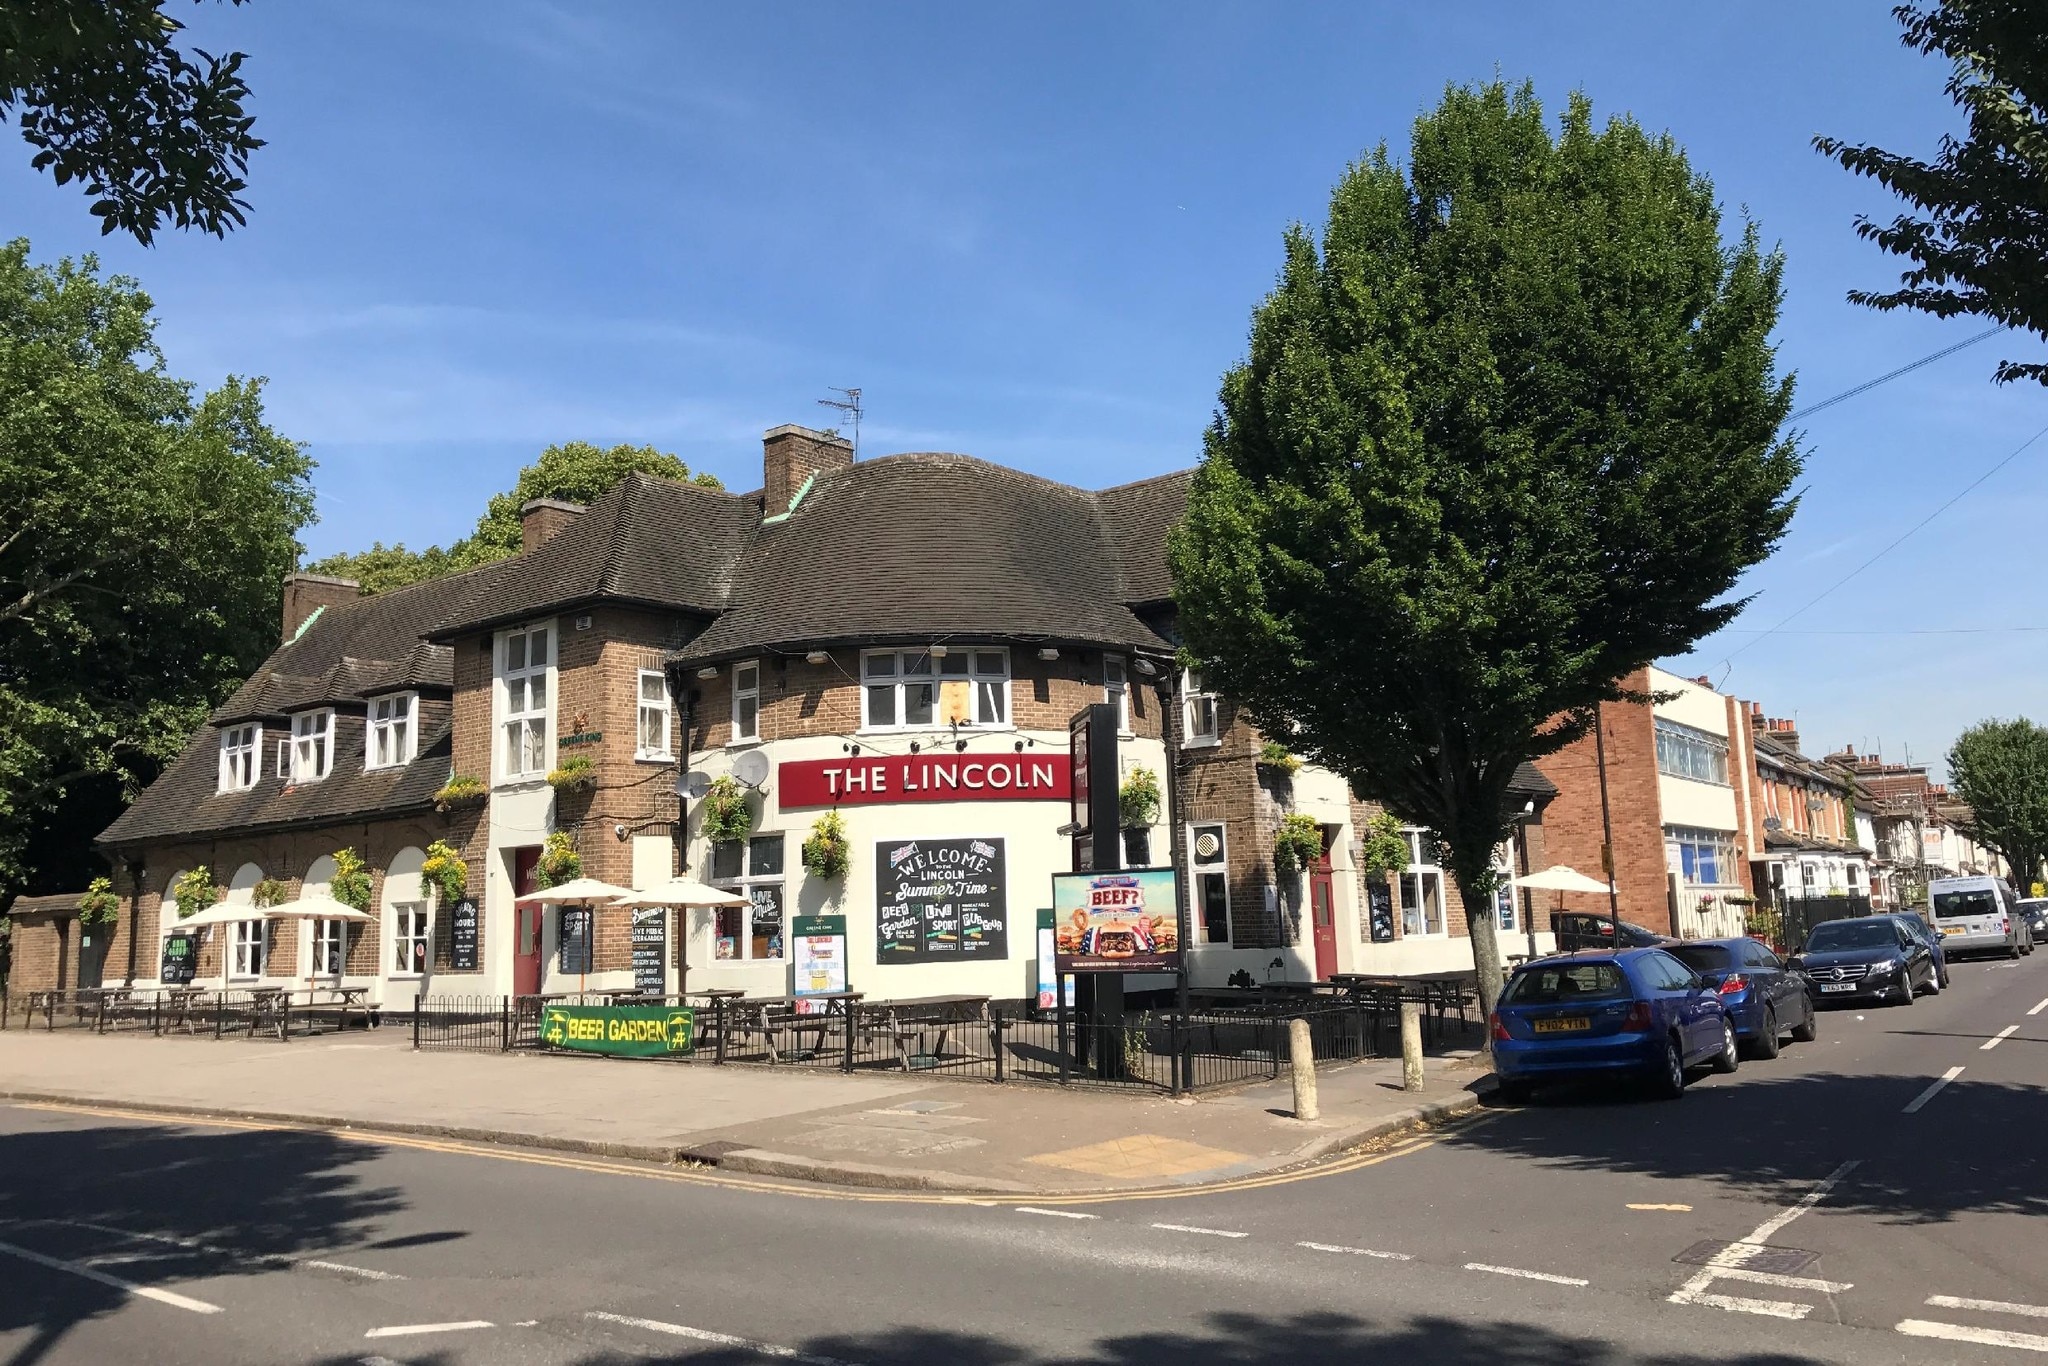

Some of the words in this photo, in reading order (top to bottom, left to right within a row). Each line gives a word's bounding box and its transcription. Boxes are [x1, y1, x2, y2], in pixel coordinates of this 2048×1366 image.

[823, 767, 887, 794] THE
[903, 763, 1054, 790] LINCOLN
[898, 849, 988, 876] WELCOME
[921, 870, 965, 881] LINCOLN
[896, 882, 956, 902] Summer
[956, 881, 988, 897] Time
[1092, 889, 1139, 906] BEEF?
[454, 919, 475, 928] HOURS
[879, 916, 920, 939] Garden
[932, 920, 958, 931] SPORT
[962, 913, 982, 926] PUB
[568, 1018, 604, 1040] BEER
[608, 1019, 668, 1042] GARDEN
